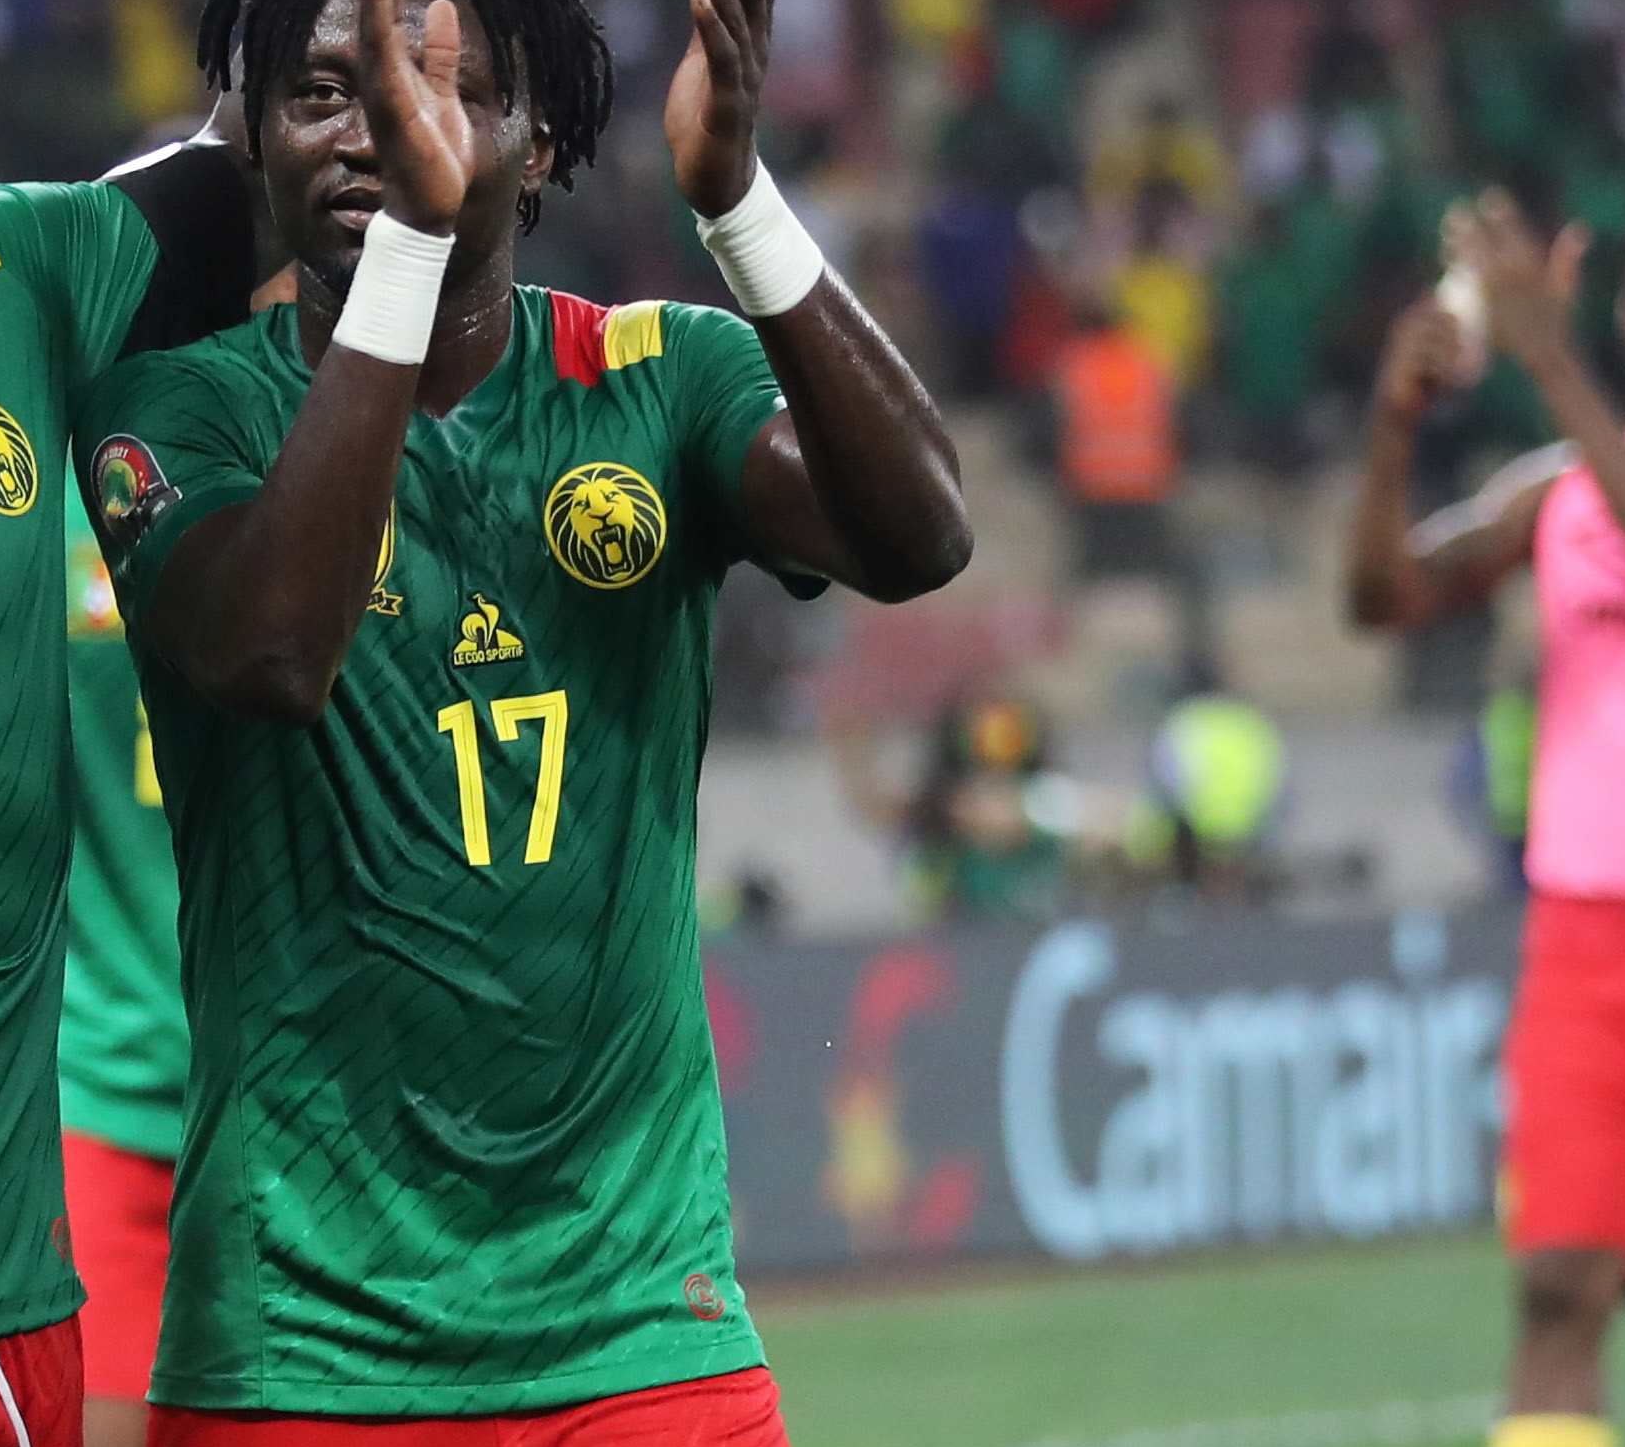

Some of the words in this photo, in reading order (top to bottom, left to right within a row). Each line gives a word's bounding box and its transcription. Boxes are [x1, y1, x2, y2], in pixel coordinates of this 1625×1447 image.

[454, 652, 465, 666] LE
[485, 644, 524, 662] SPORTIF
[437, 689, 569, 866] 17
